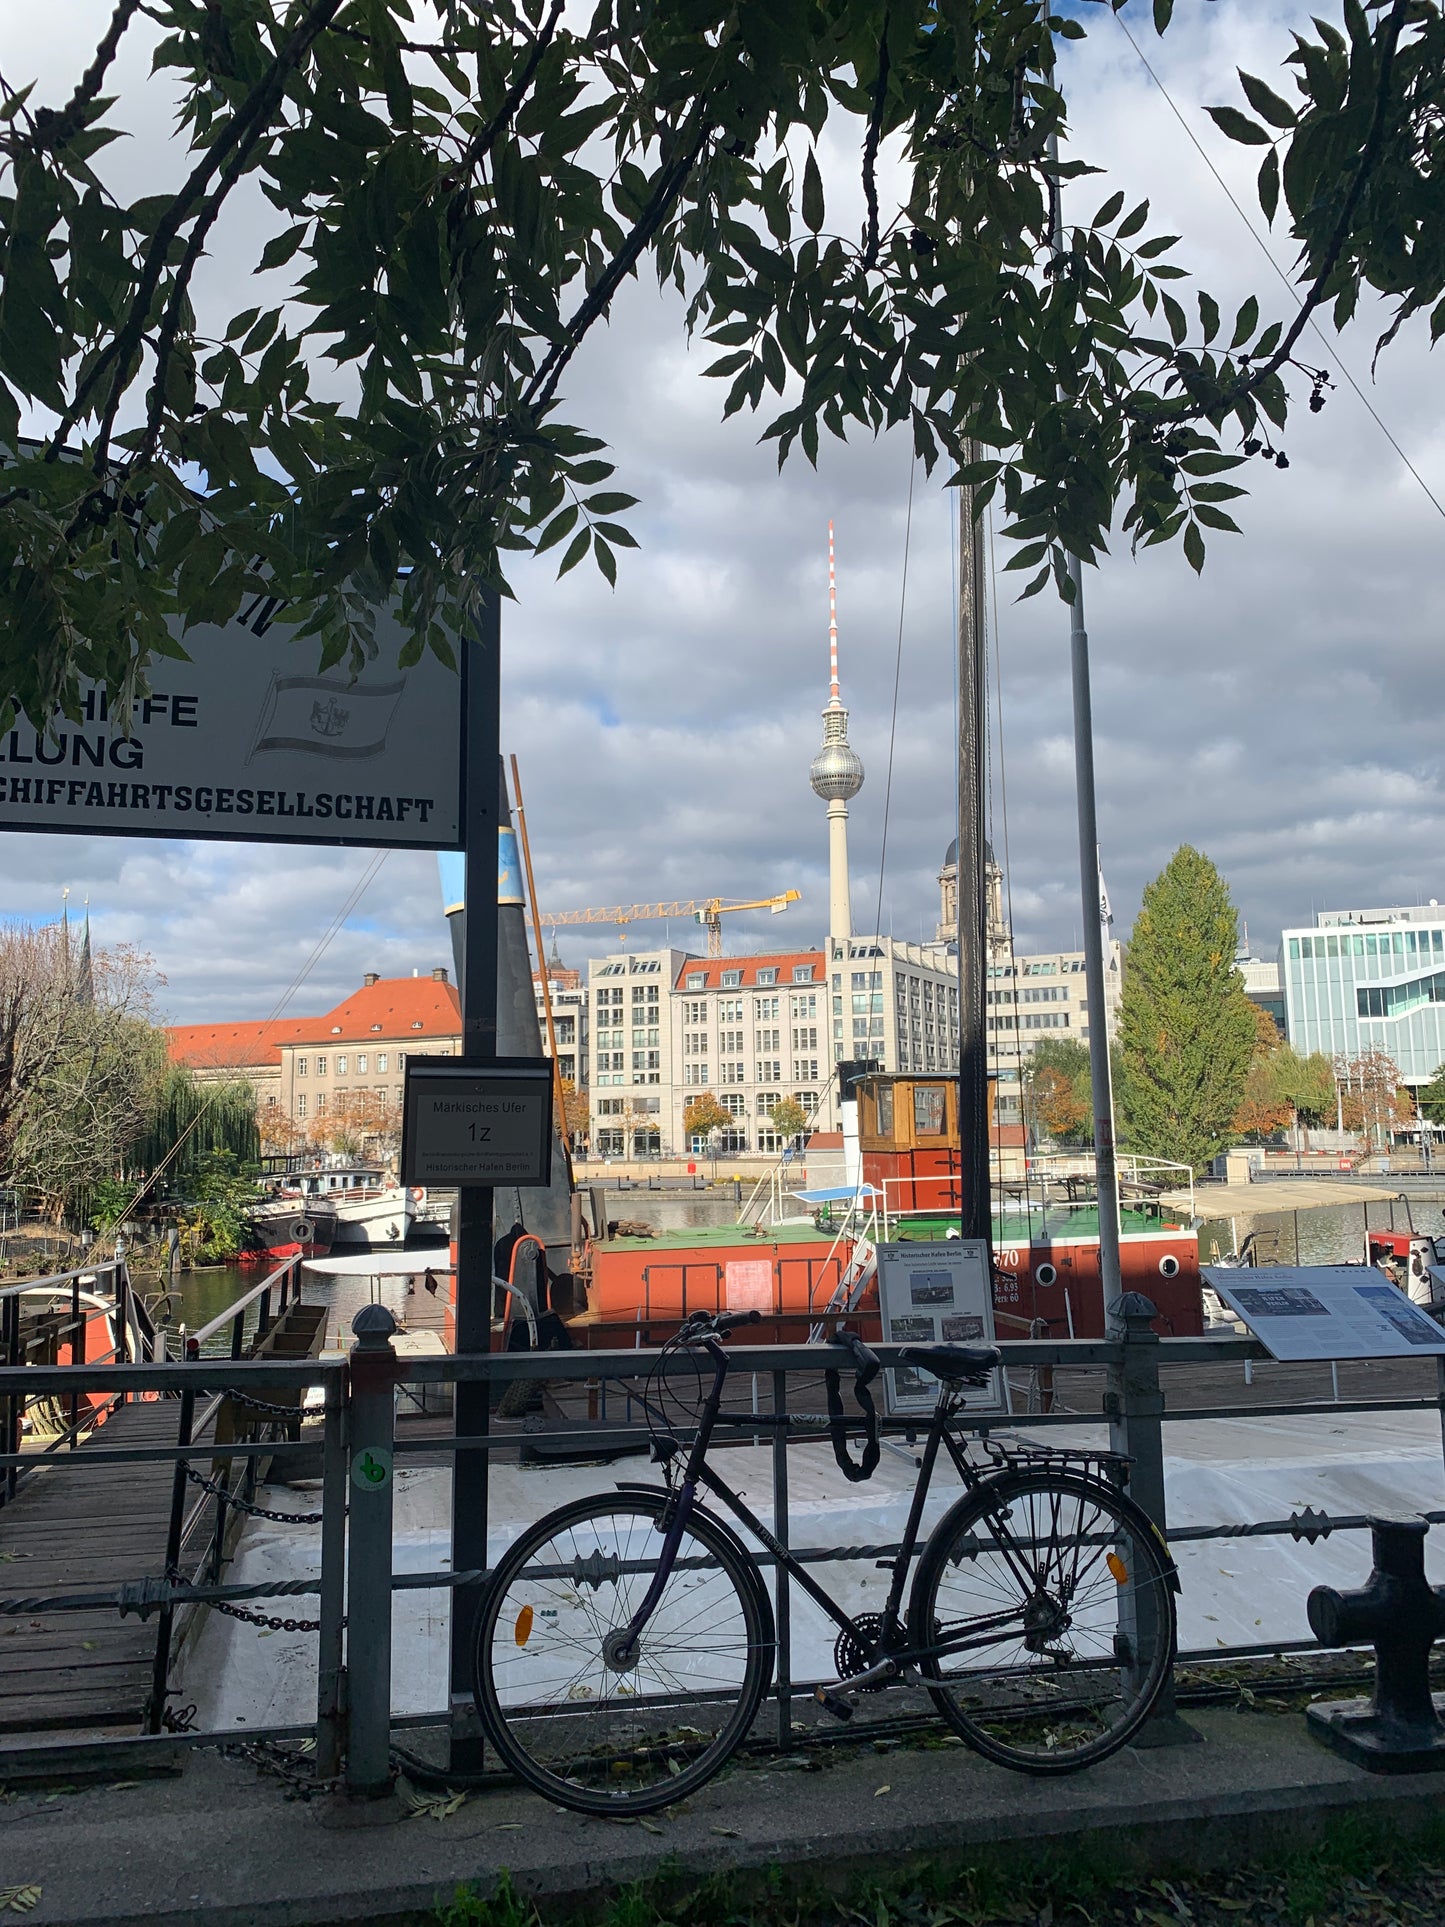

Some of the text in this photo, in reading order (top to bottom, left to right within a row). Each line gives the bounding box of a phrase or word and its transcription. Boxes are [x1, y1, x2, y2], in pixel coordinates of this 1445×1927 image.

[0, 731, 144, 769] LUNG
[433, 1102, 526, 1113] Märkisches Ufer
[467, 1122, 492, 1142] 1z
[425, 1162, 530, 1172] Historischer Hafen Berlin
